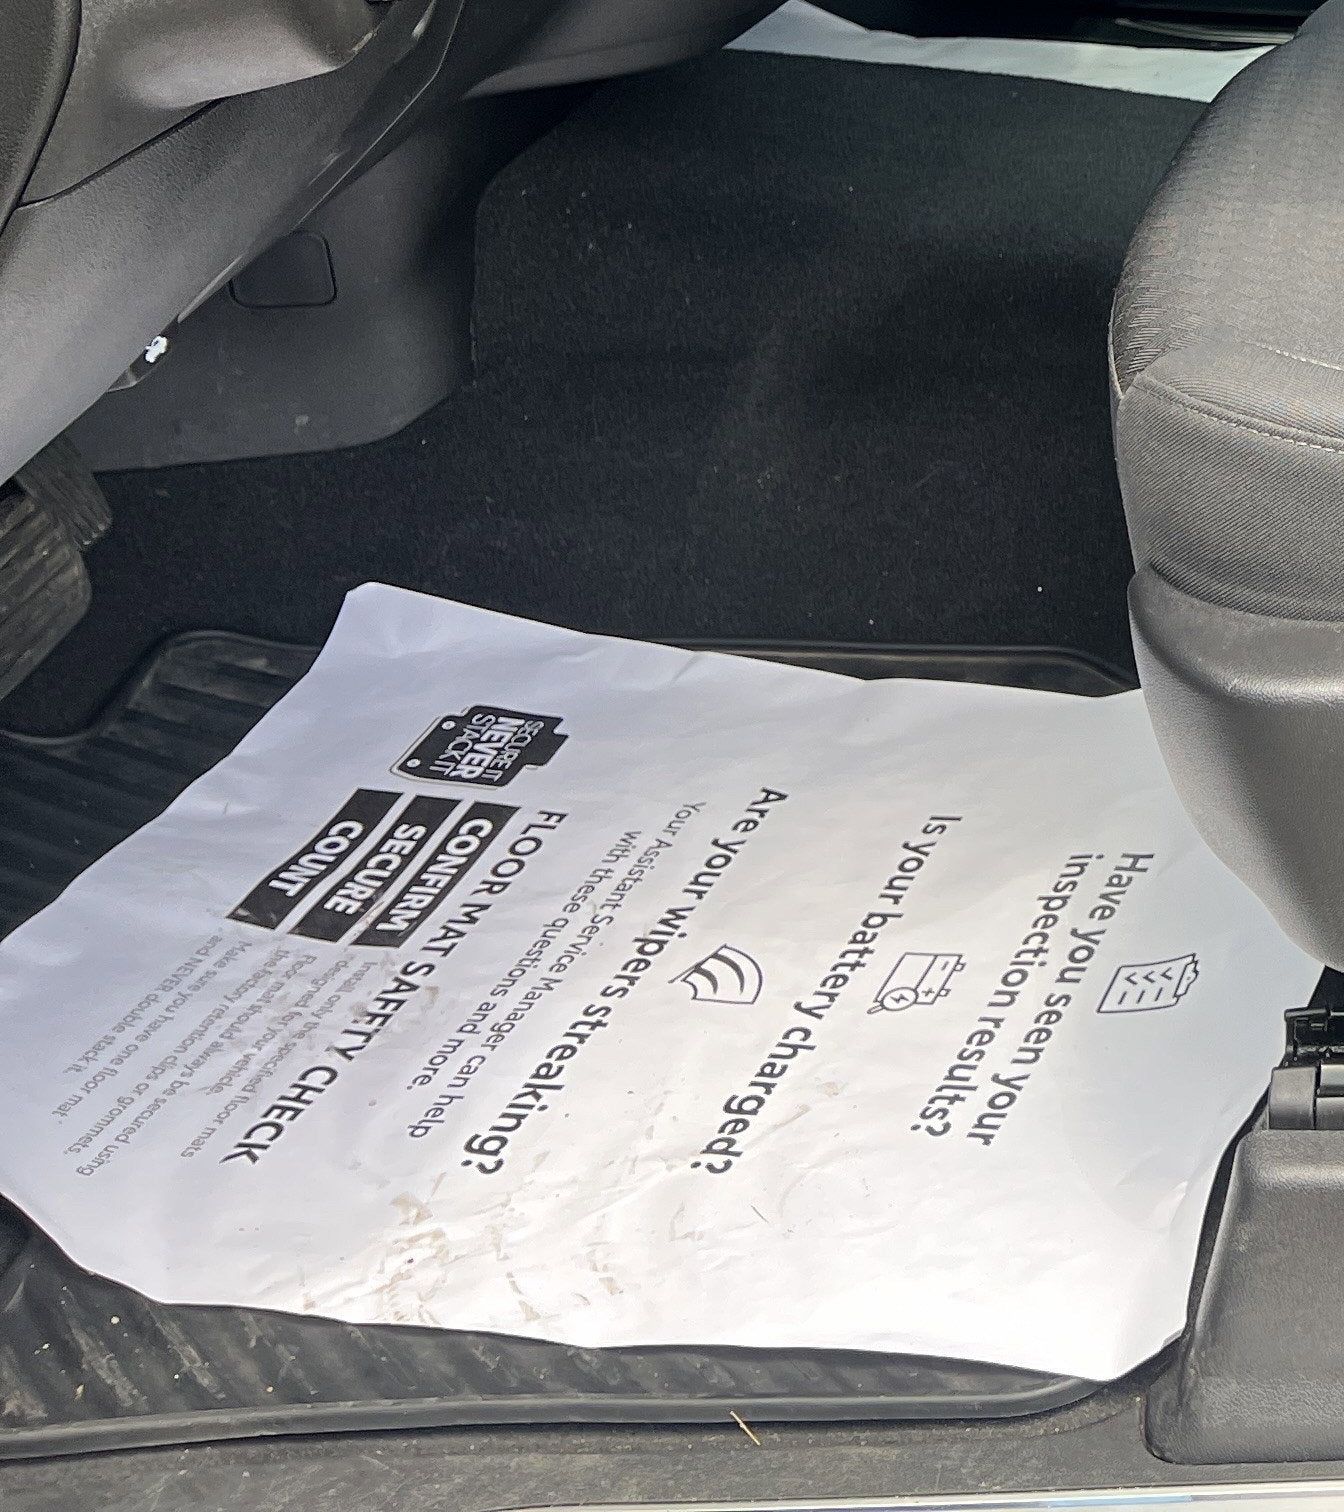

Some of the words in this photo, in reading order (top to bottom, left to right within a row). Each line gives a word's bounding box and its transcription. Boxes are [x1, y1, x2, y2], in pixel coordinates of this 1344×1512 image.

[438, 713, 496, 761] STACK
[449, 716, 526, 780] NEVER
[489, 719, 545, 770] SECURE
[429, 759, 457, 776] IT
[481, 768, 504, 783] IT
[660, 800, 707, 838] Your
[730, 785, 789, 842] Are
[920, 814, 963, 835] Is
[267, 819, 363, 897] COUNT
[322, 823, 426, 915] SECURE
[468, 808, 569, 897] FLOOR
[599, 829, 643, 864] with
[680, 836, 748, 901] your
[374, 817, 493, 931] CONFIRM
[560, 866, 615, 914] these
[601, 836, 674, 913] Assistant
[876, 839, 938, 906] your
[1087, 851, 1155, 922] Have
[193, 934, 223, 957] and
[418, 901, 493, 958] MAT
[546, 911, 614, 974] Service
[598, 904, 697, 999] wipers
[985, 852, 1105, 1008] inspection
[153, 955, 204, 993] NEVER
[211, 939, 253, 969] Make
[261, 947, 292, 968] the
[280, 953, 318, 981] Floor
[333, 960, 379, 993] Install
[488, 915, 570, 998] questions
[791, 910, 905, 1021] battery
[1053, 926, 1108, 984] you
[163, 989, 193, 1014] you
[185, 969, 218, 997] sure
[221, 966, 275, 1004] factory
[254, 979, 286, 1005] mat
[290, 958, 350, 1009] designed
[110, 992, 161, 1034] double
[133, 1013, 175, 1043] have
[171, 1002, 230, 1054] retention
[217, 1002, 266, 1041] should
[275, 1010, 304, 1028] for
[309, 993, 342, 1020] only
[453, 1000, 498, 1036] and
[479, 975, 564, 1052] Manager
[1009, 991, 1072, 1065] seen
[75, 1033, 117, 1066] stack
[248, 1025, 284, 1052] your
[289, 1020, 321, 1040] the
[61, 1062, 88, 1074] it.
[108, 1042, 140, 1066] one
[144, 1053, 179, 1081] clips
[181, 1039, 225, 1081] always
[204, 1051, 258, 1096] vehicle.
[239, 1040, 298, 1094] specified
[405, 1036, 467, 1091] more.
[445, 1053, 488, 1099] can
[909, 1015, 1006, 1137] results?
[78, 1065, 119, 1095] floor
[130, 1081, 150, 1097] or
[160, 1078, 191, 1097] be
[459, 1002, 613, 1175] streaking?
[689, 1025, 817, 1175] charged?
[50, 1092, 84, 1118] mat
[61, 1094, 135, 1155] grommets.
[112, 1096, 168, 1145] secured
[211, 1094, 251, 1126] floor
[218, 1064, 339, 1165] CHECK
[405, 1092, 464, 1139] help
[965, 1071, 1031, 1147] your
[74, 1143, 120, 1177] using
[179, 1125, 218, 1158] mats
